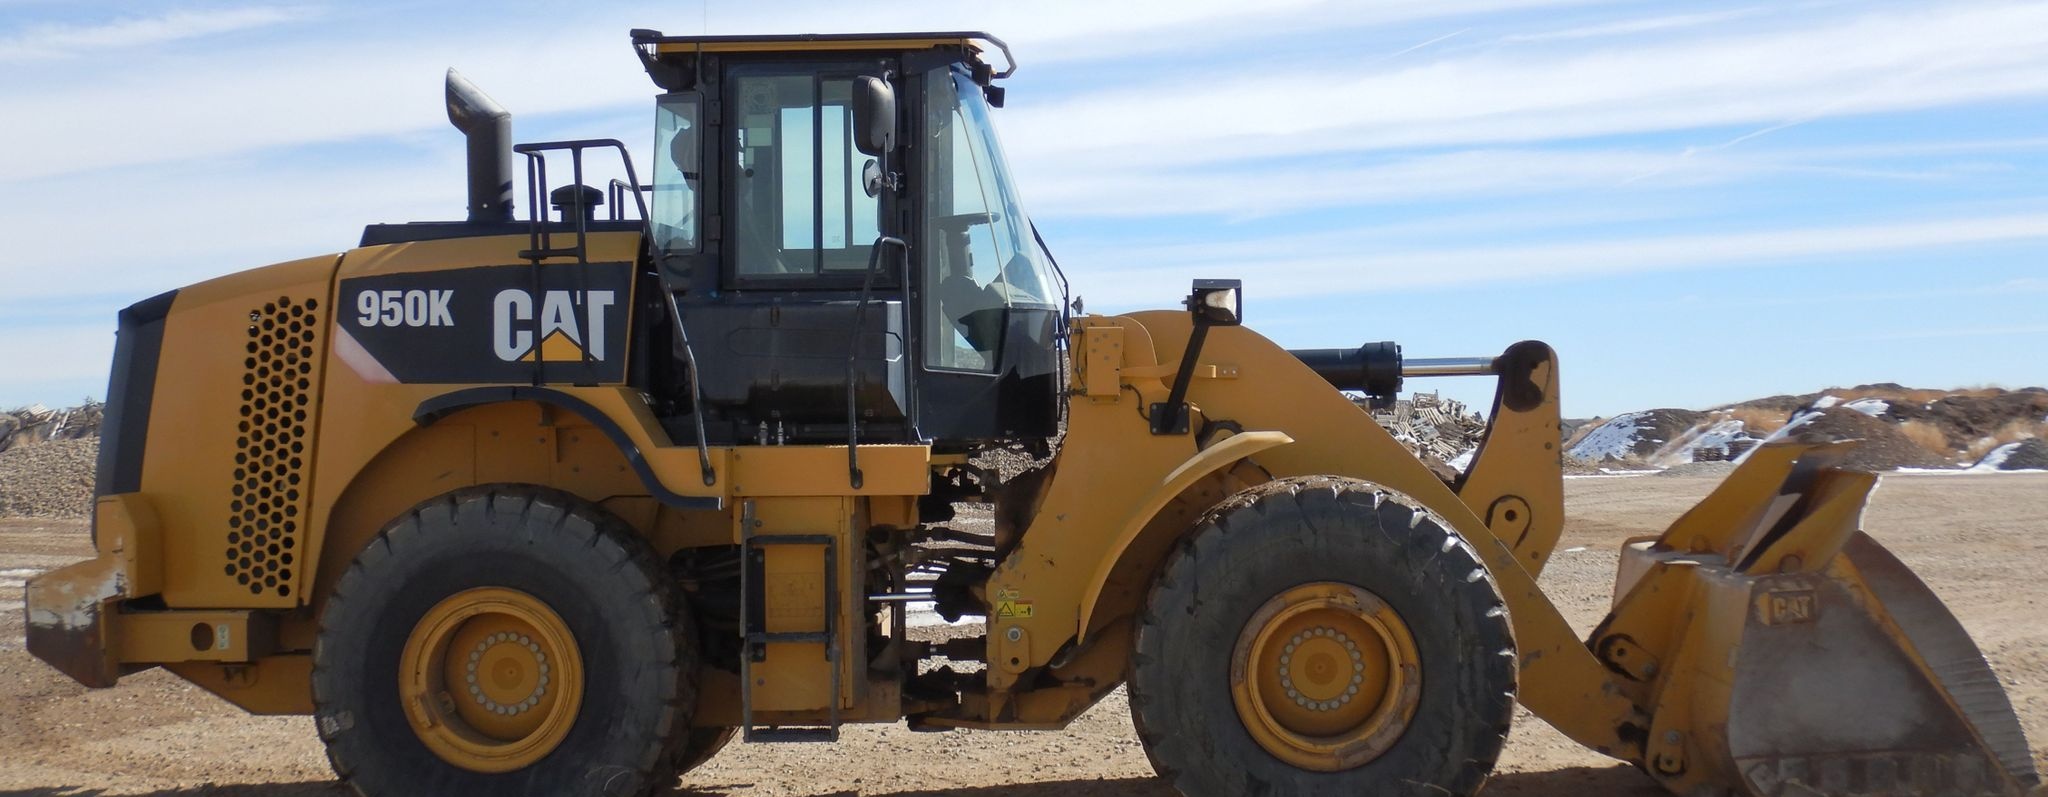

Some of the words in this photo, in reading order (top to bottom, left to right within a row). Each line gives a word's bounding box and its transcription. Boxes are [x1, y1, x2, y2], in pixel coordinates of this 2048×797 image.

[357, 289, 455, 327] 950K
[493, 289, 615, 362] CAT
[1772, 595, 1811, 621] CAT
